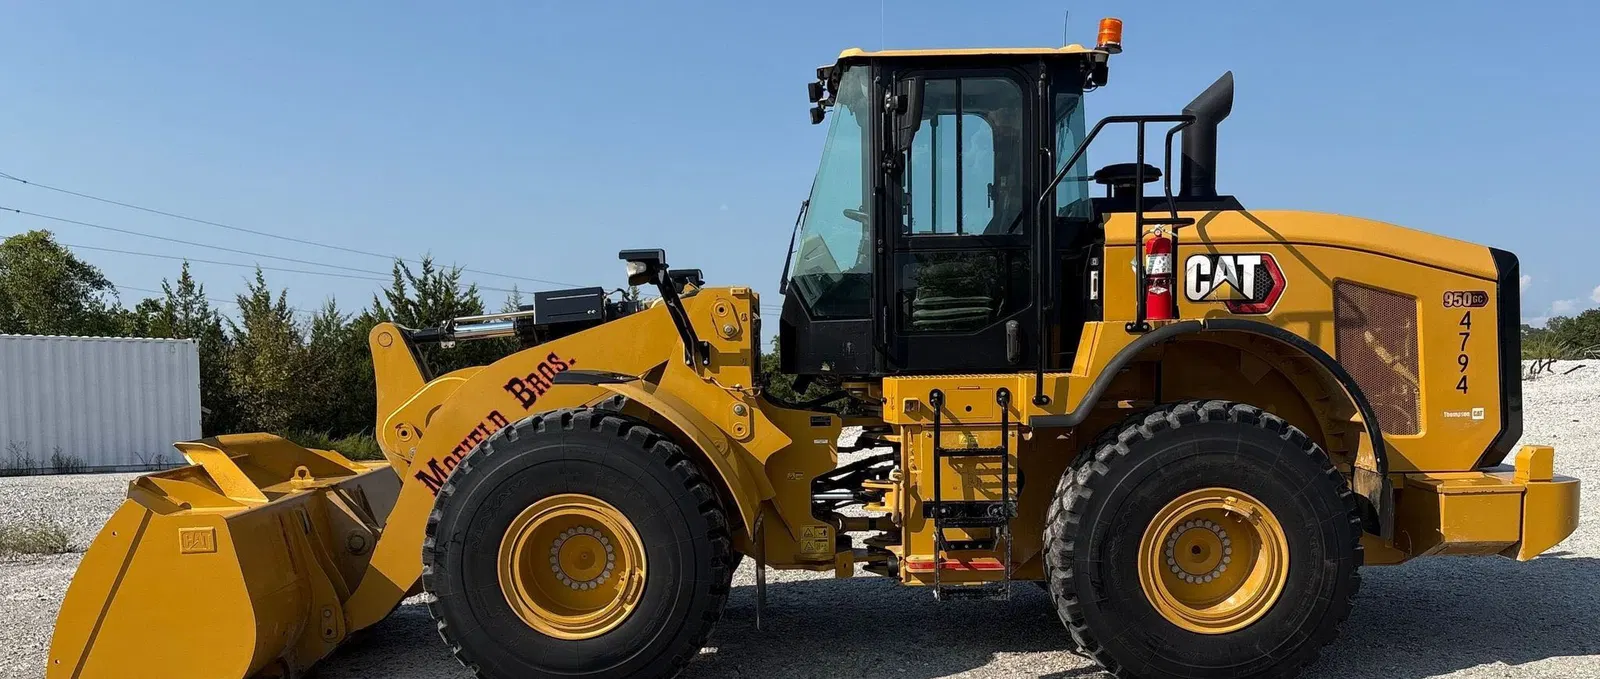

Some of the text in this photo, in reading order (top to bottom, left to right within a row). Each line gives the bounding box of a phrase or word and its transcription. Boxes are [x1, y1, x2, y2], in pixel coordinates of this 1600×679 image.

[1186, 255, 1261, 301] CAT
[1443, 291, 1472, 307] 950
[1456, 310, 1471, 395] 4794
[182, 530, 211, 550] CAT
